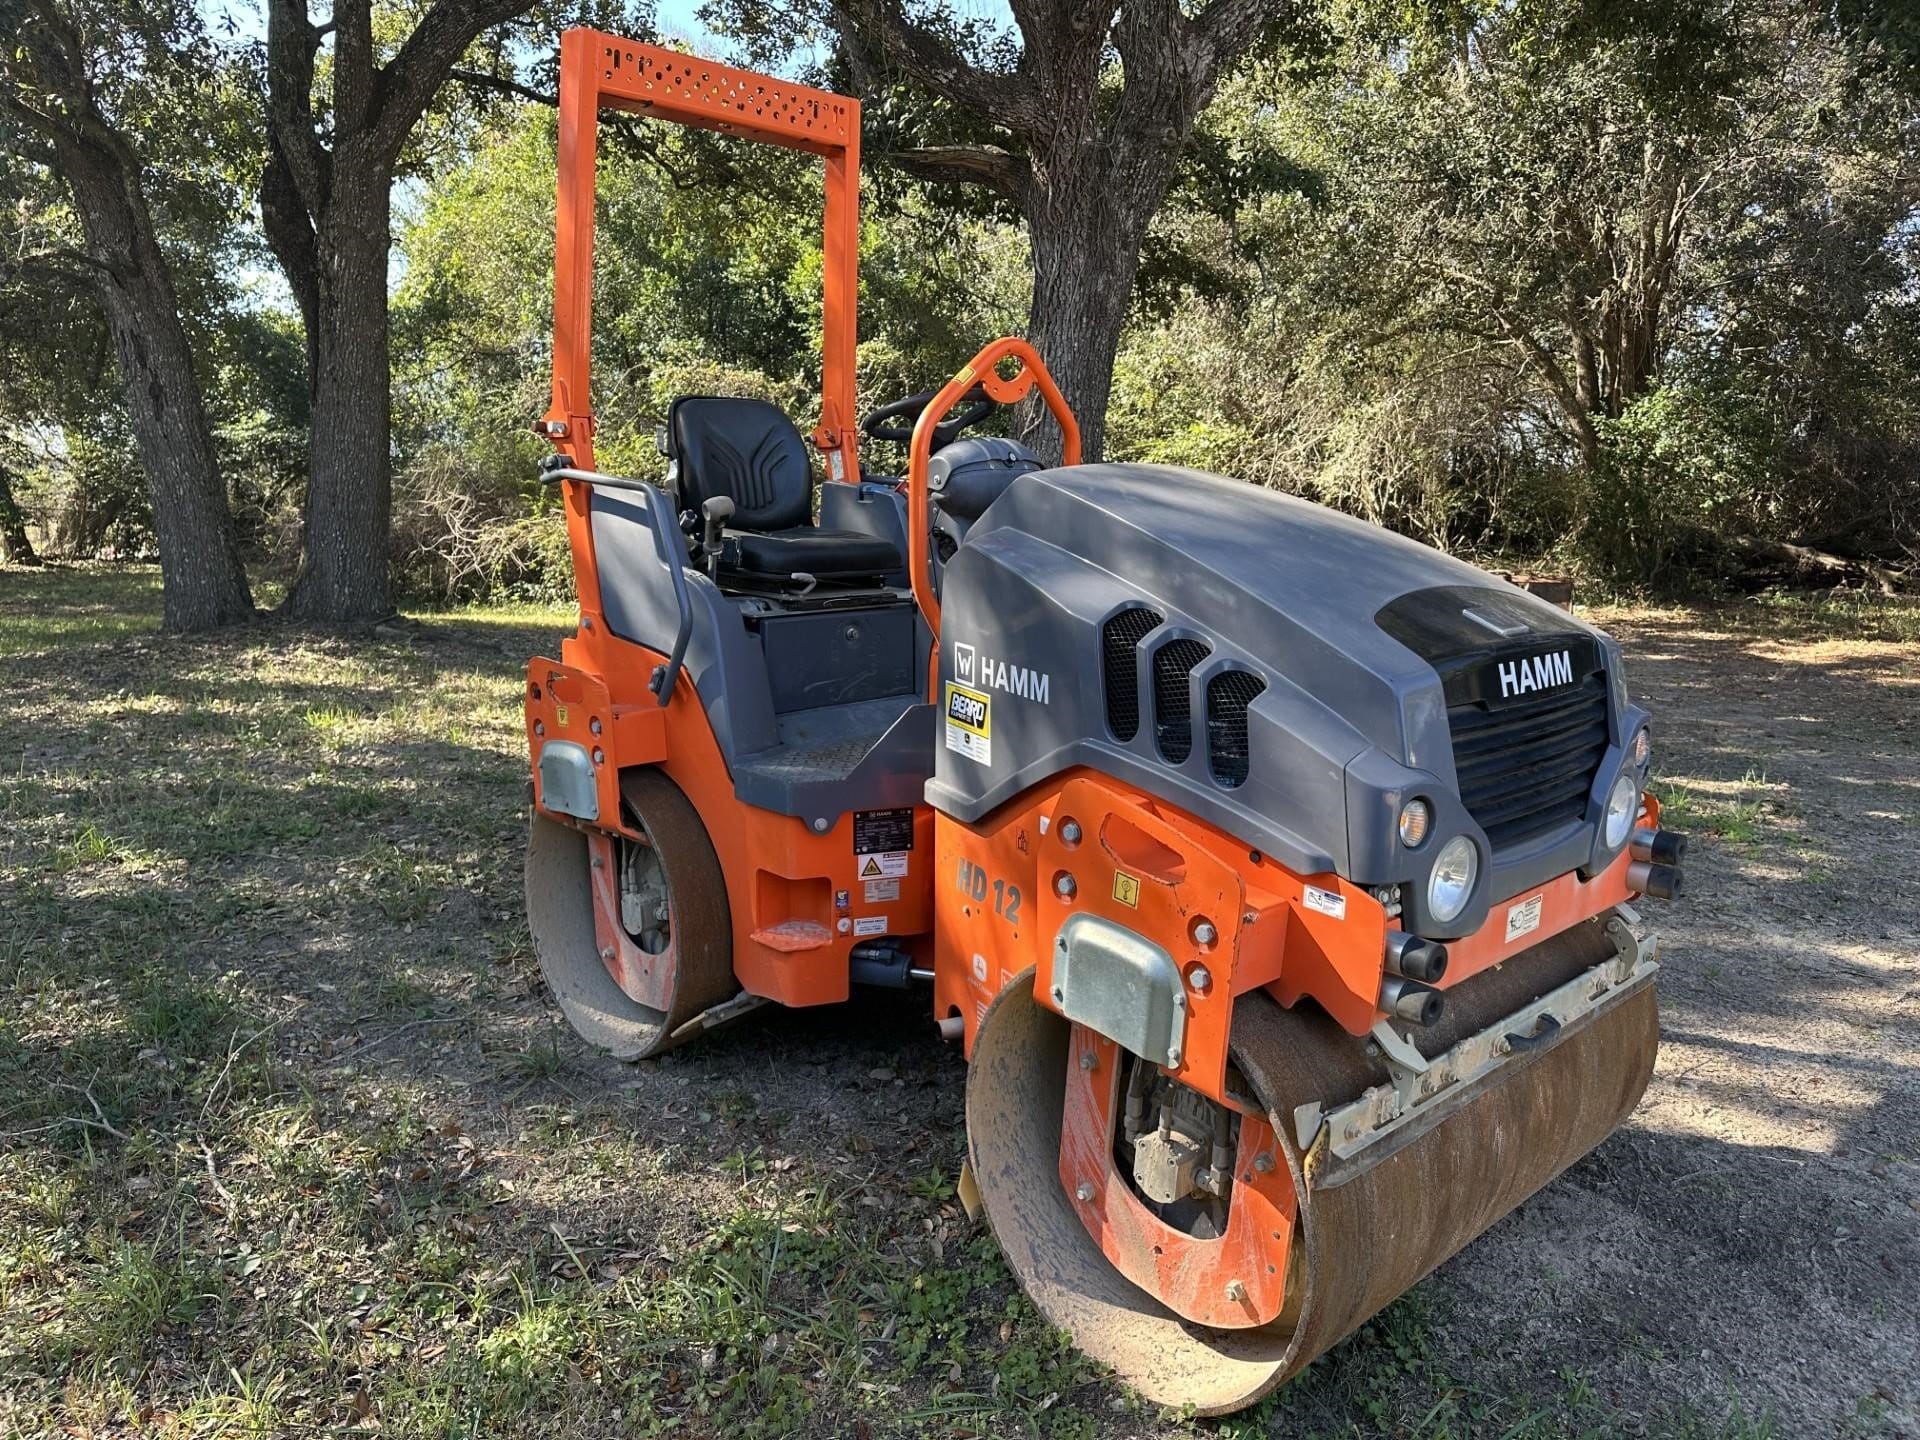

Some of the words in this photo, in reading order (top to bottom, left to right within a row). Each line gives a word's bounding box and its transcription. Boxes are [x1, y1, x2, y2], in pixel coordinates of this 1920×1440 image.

[981, 656, 1049, 705] HAMM
[1498, 650, 1573, 698] HAMM
[951, 693, 985, 727] BEARD
[957, 856, 988, 903] HD
[993, 878, 1022, 926] 12
